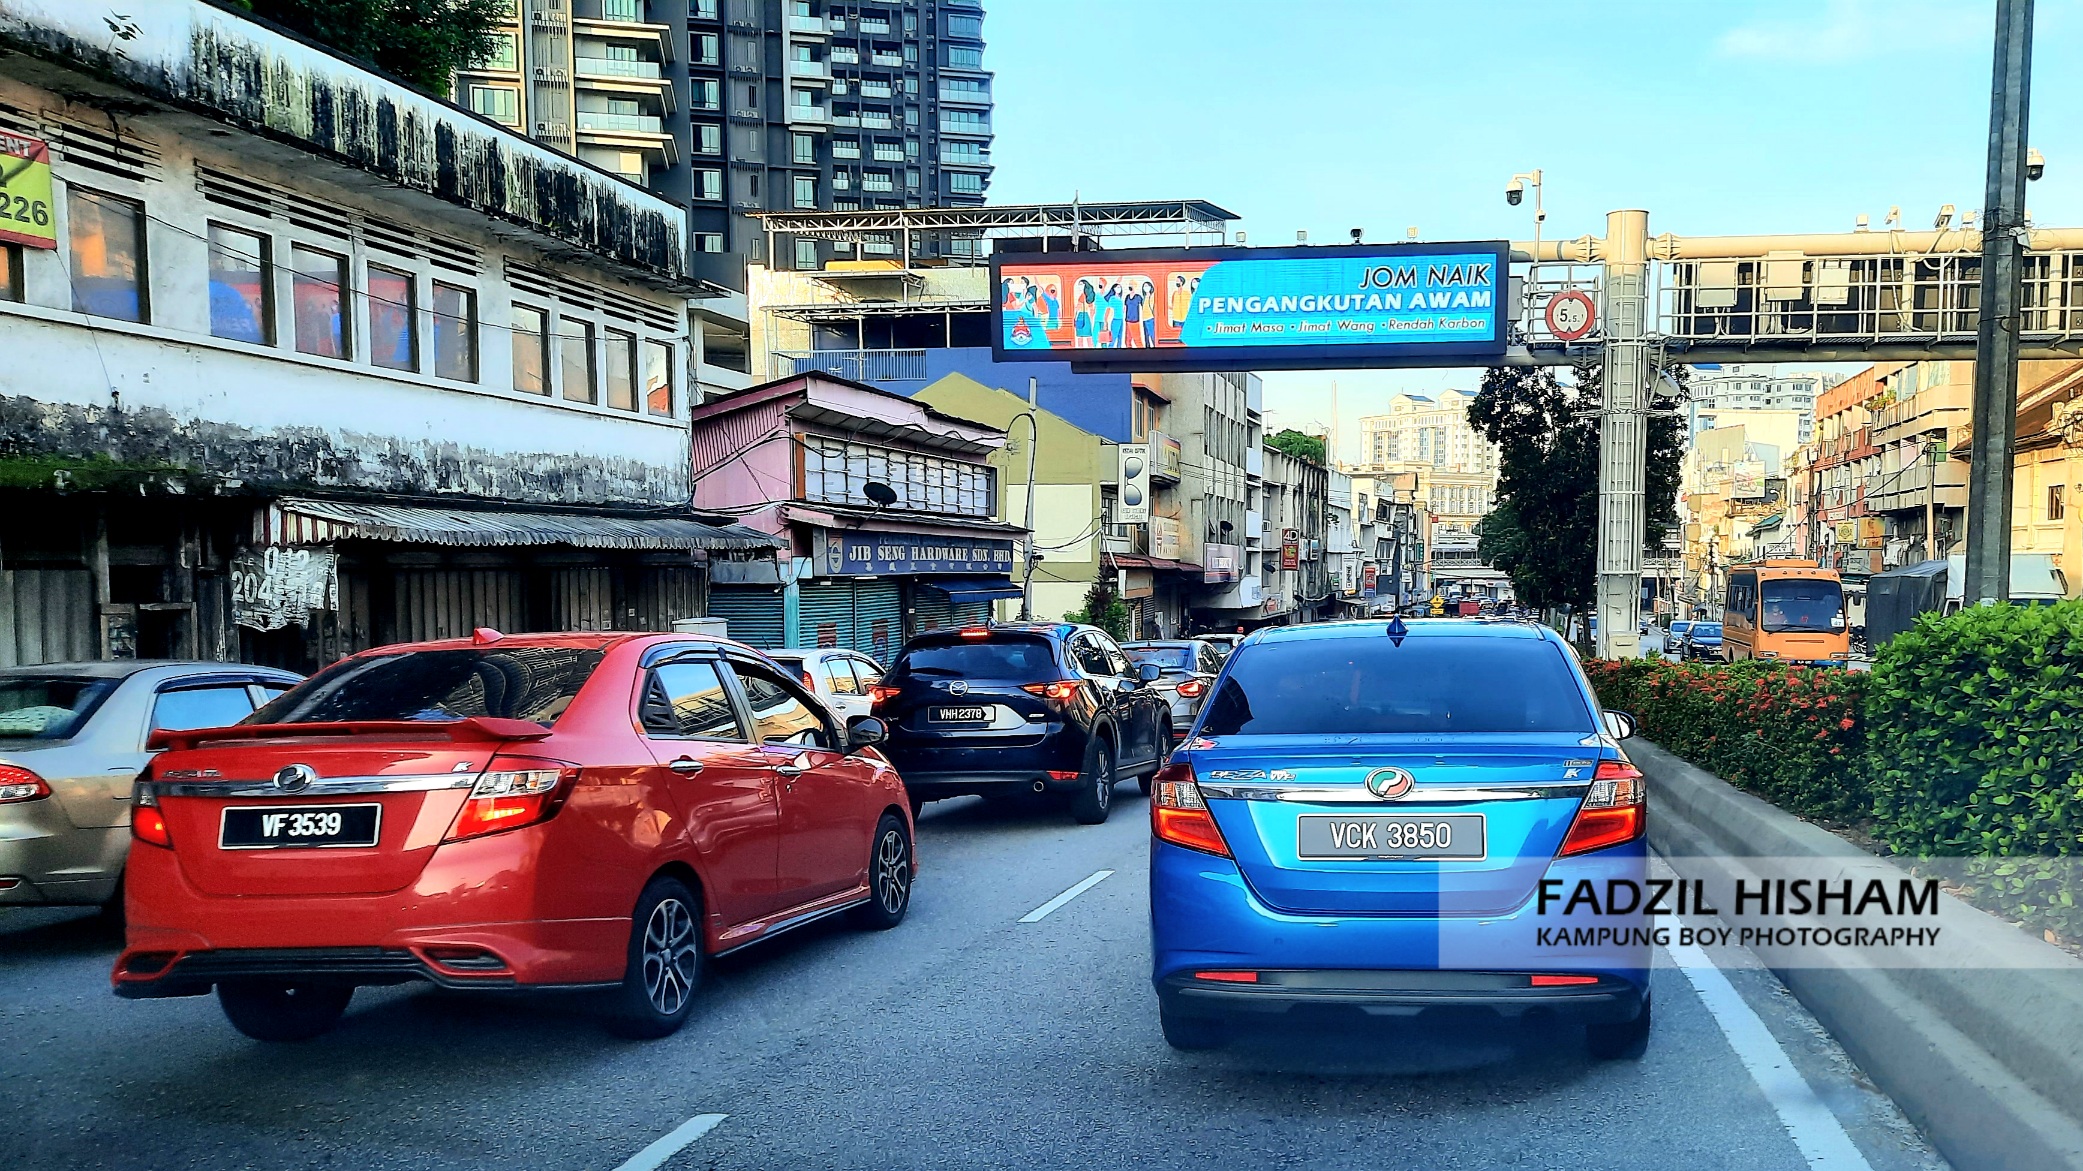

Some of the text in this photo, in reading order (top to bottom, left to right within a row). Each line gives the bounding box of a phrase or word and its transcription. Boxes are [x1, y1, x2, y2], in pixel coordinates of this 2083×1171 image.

[1359, 264, 1490, 288] JOM NAIK
[1199, 291, 1491, 313] PENGANGKUTAN AWAM
[1214, 317, 1485, 334] Jimat Masa Jimat Wang Rendah Karbon
[1283, 530, 1298, 541] 4D
[850, 545, 872, 561] JIB
[878, 545, 906, 561] SENG
[911, 546, 968, 562] HARDWARE
[972, 548, 991, 562] SDN.
[1330, 821, 1452, 849] VCK 3850
